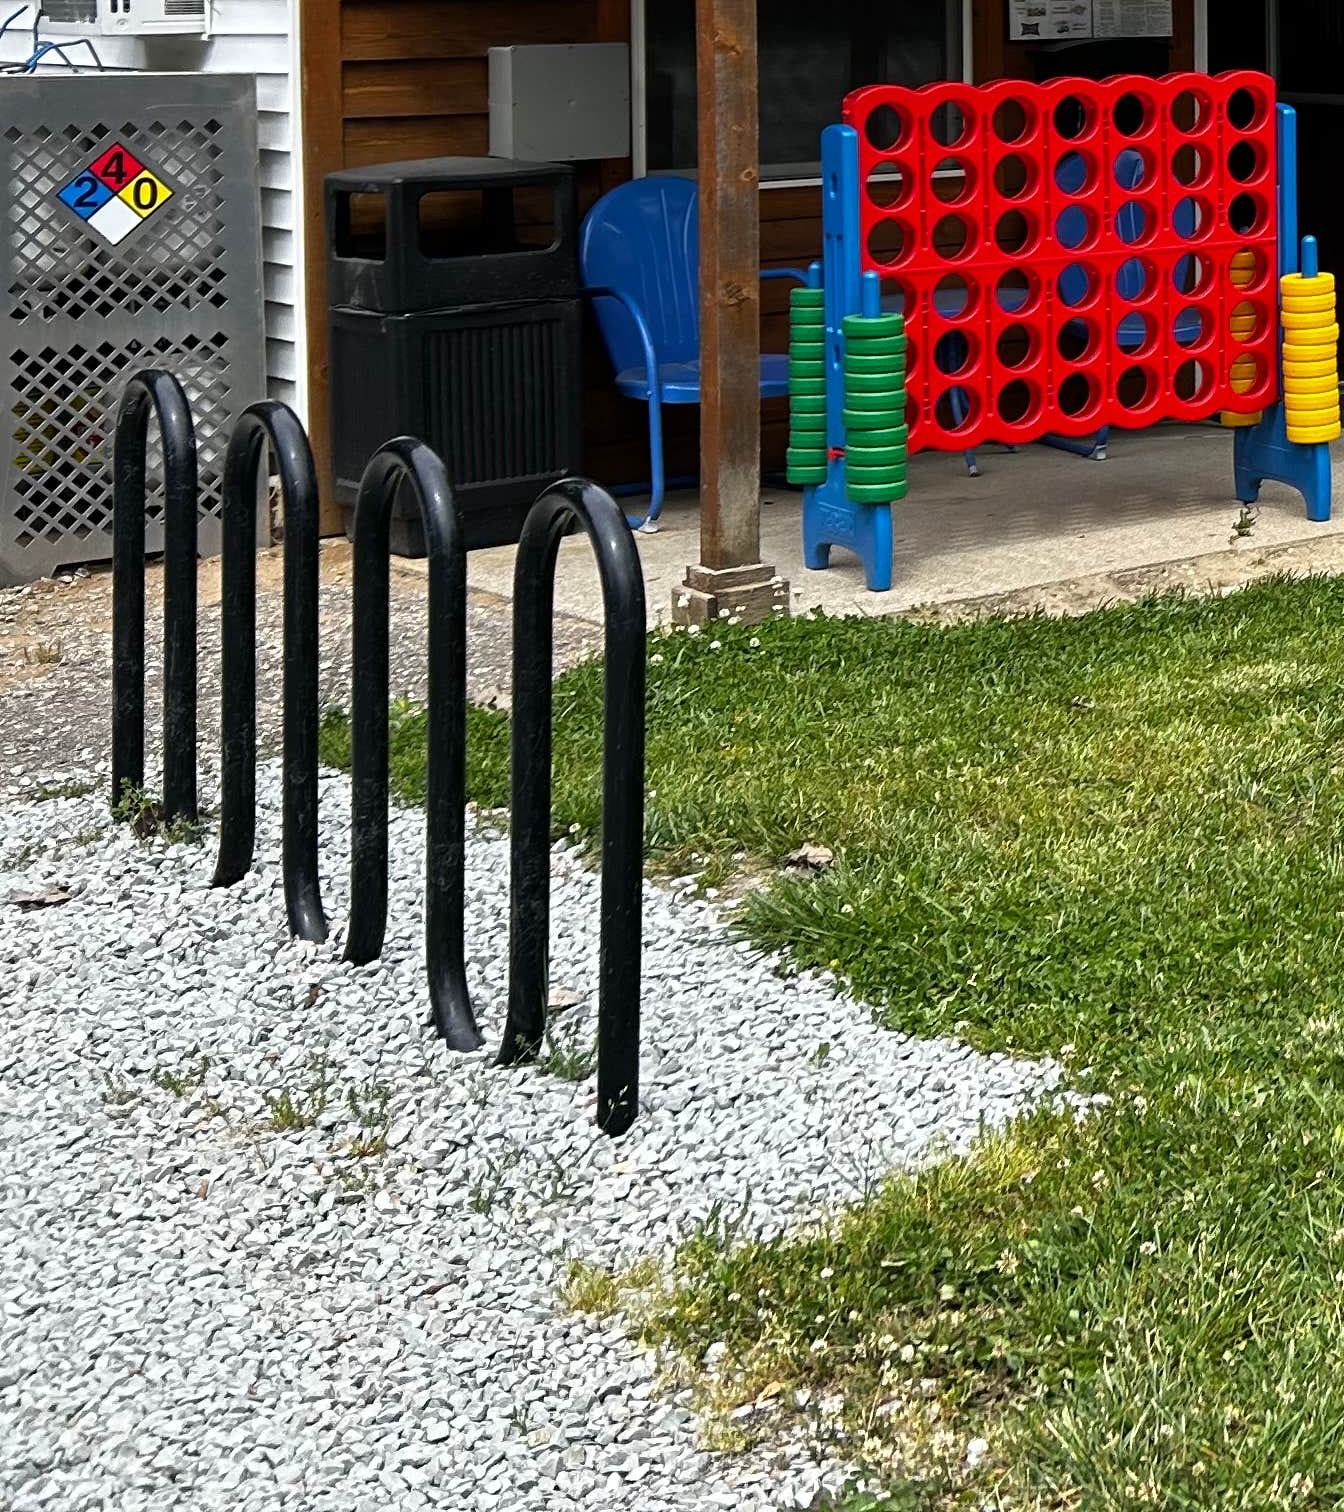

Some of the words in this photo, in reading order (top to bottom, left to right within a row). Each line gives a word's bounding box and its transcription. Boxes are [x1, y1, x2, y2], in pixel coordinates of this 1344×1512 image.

[101, 151, 127, 185] 4
[73, 176, 99, 207] 2
[133, 177, 158, 210] 0
